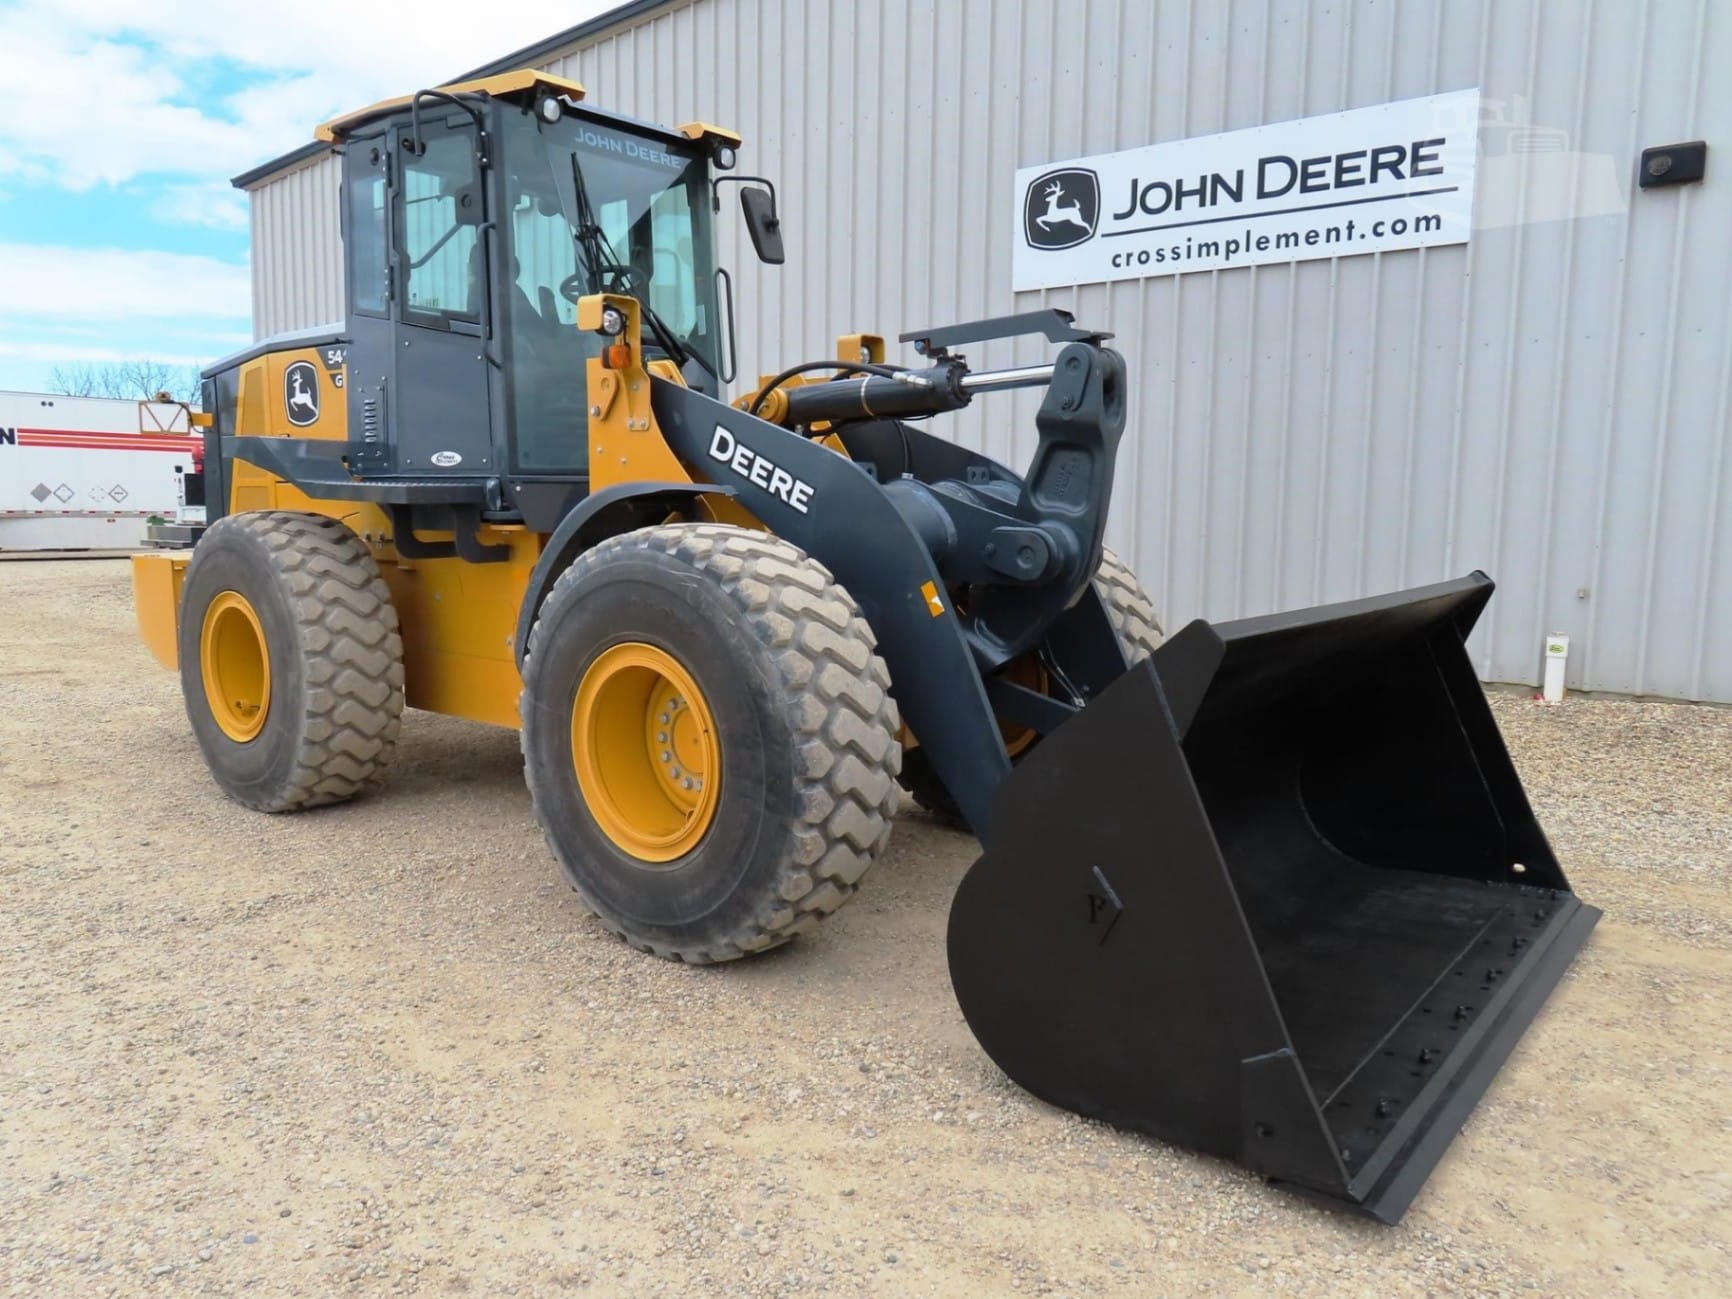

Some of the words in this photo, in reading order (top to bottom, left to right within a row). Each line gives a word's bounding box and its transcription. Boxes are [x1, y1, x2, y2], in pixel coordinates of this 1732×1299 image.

[575, 128, 621, 153] JOHN
[625, 141, 681, 168] DEERE
[1113, 169, 1244, 220] JOHN
[1256, 138, 1446, 200] DEERE
[1112, 213, 1441, 267] crossimplement.com
[709, 425, 815, 514] DEERE
